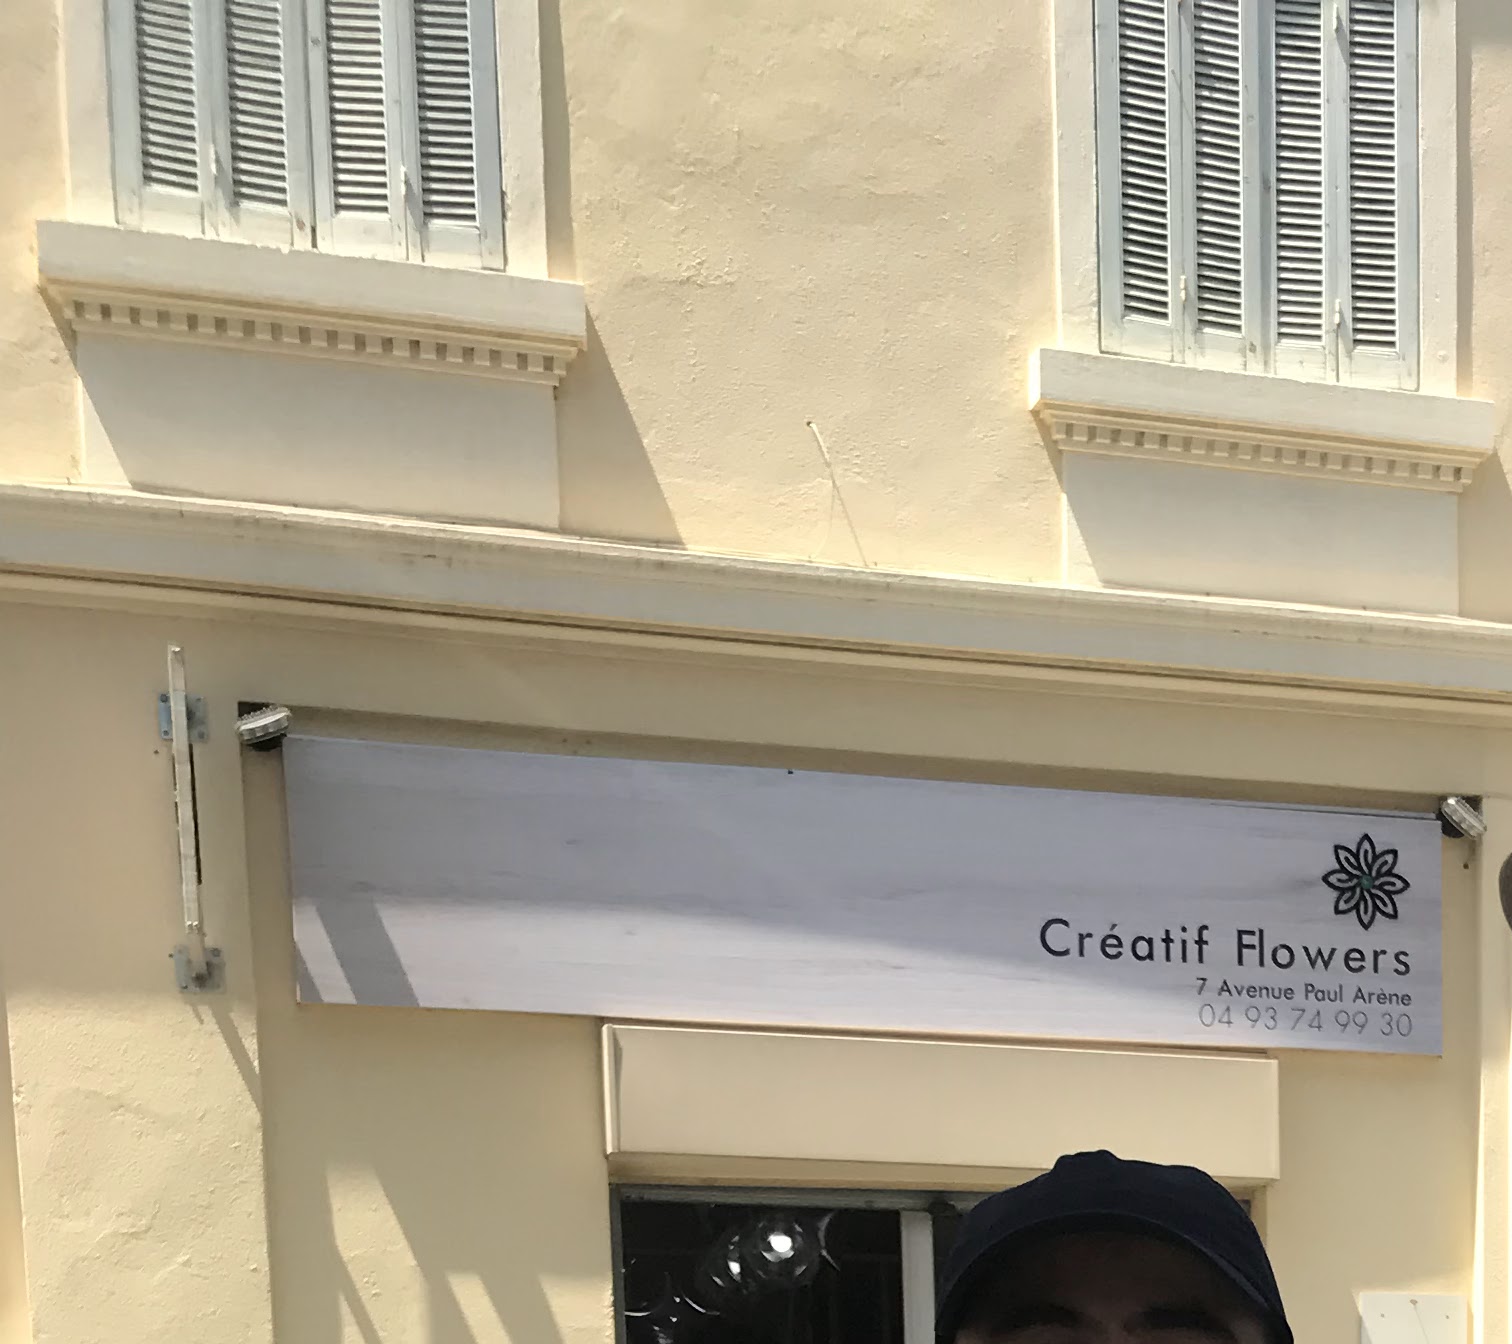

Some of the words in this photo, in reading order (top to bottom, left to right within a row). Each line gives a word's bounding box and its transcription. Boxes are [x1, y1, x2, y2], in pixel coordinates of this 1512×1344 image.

[1040, 917, 1209, 964] Créatif
[1236, 929, 1411, 976] Flowers
[1196, 977, 1208, 996] 7
[1218, 979, 1295, 1001] Avenue
[1304, 983, 1344, 1003] Paul
[1353, 986, 1412, 1007] Arène
[1199, 1004, 1232, 1028] 04
[1245, 1007, 1278, 1030] 93
[1291, 1008, 1323, 1032] 74
[1336, 1011, 1368, 1034] 99
[1380, 1013, 1412, 1037] 30
